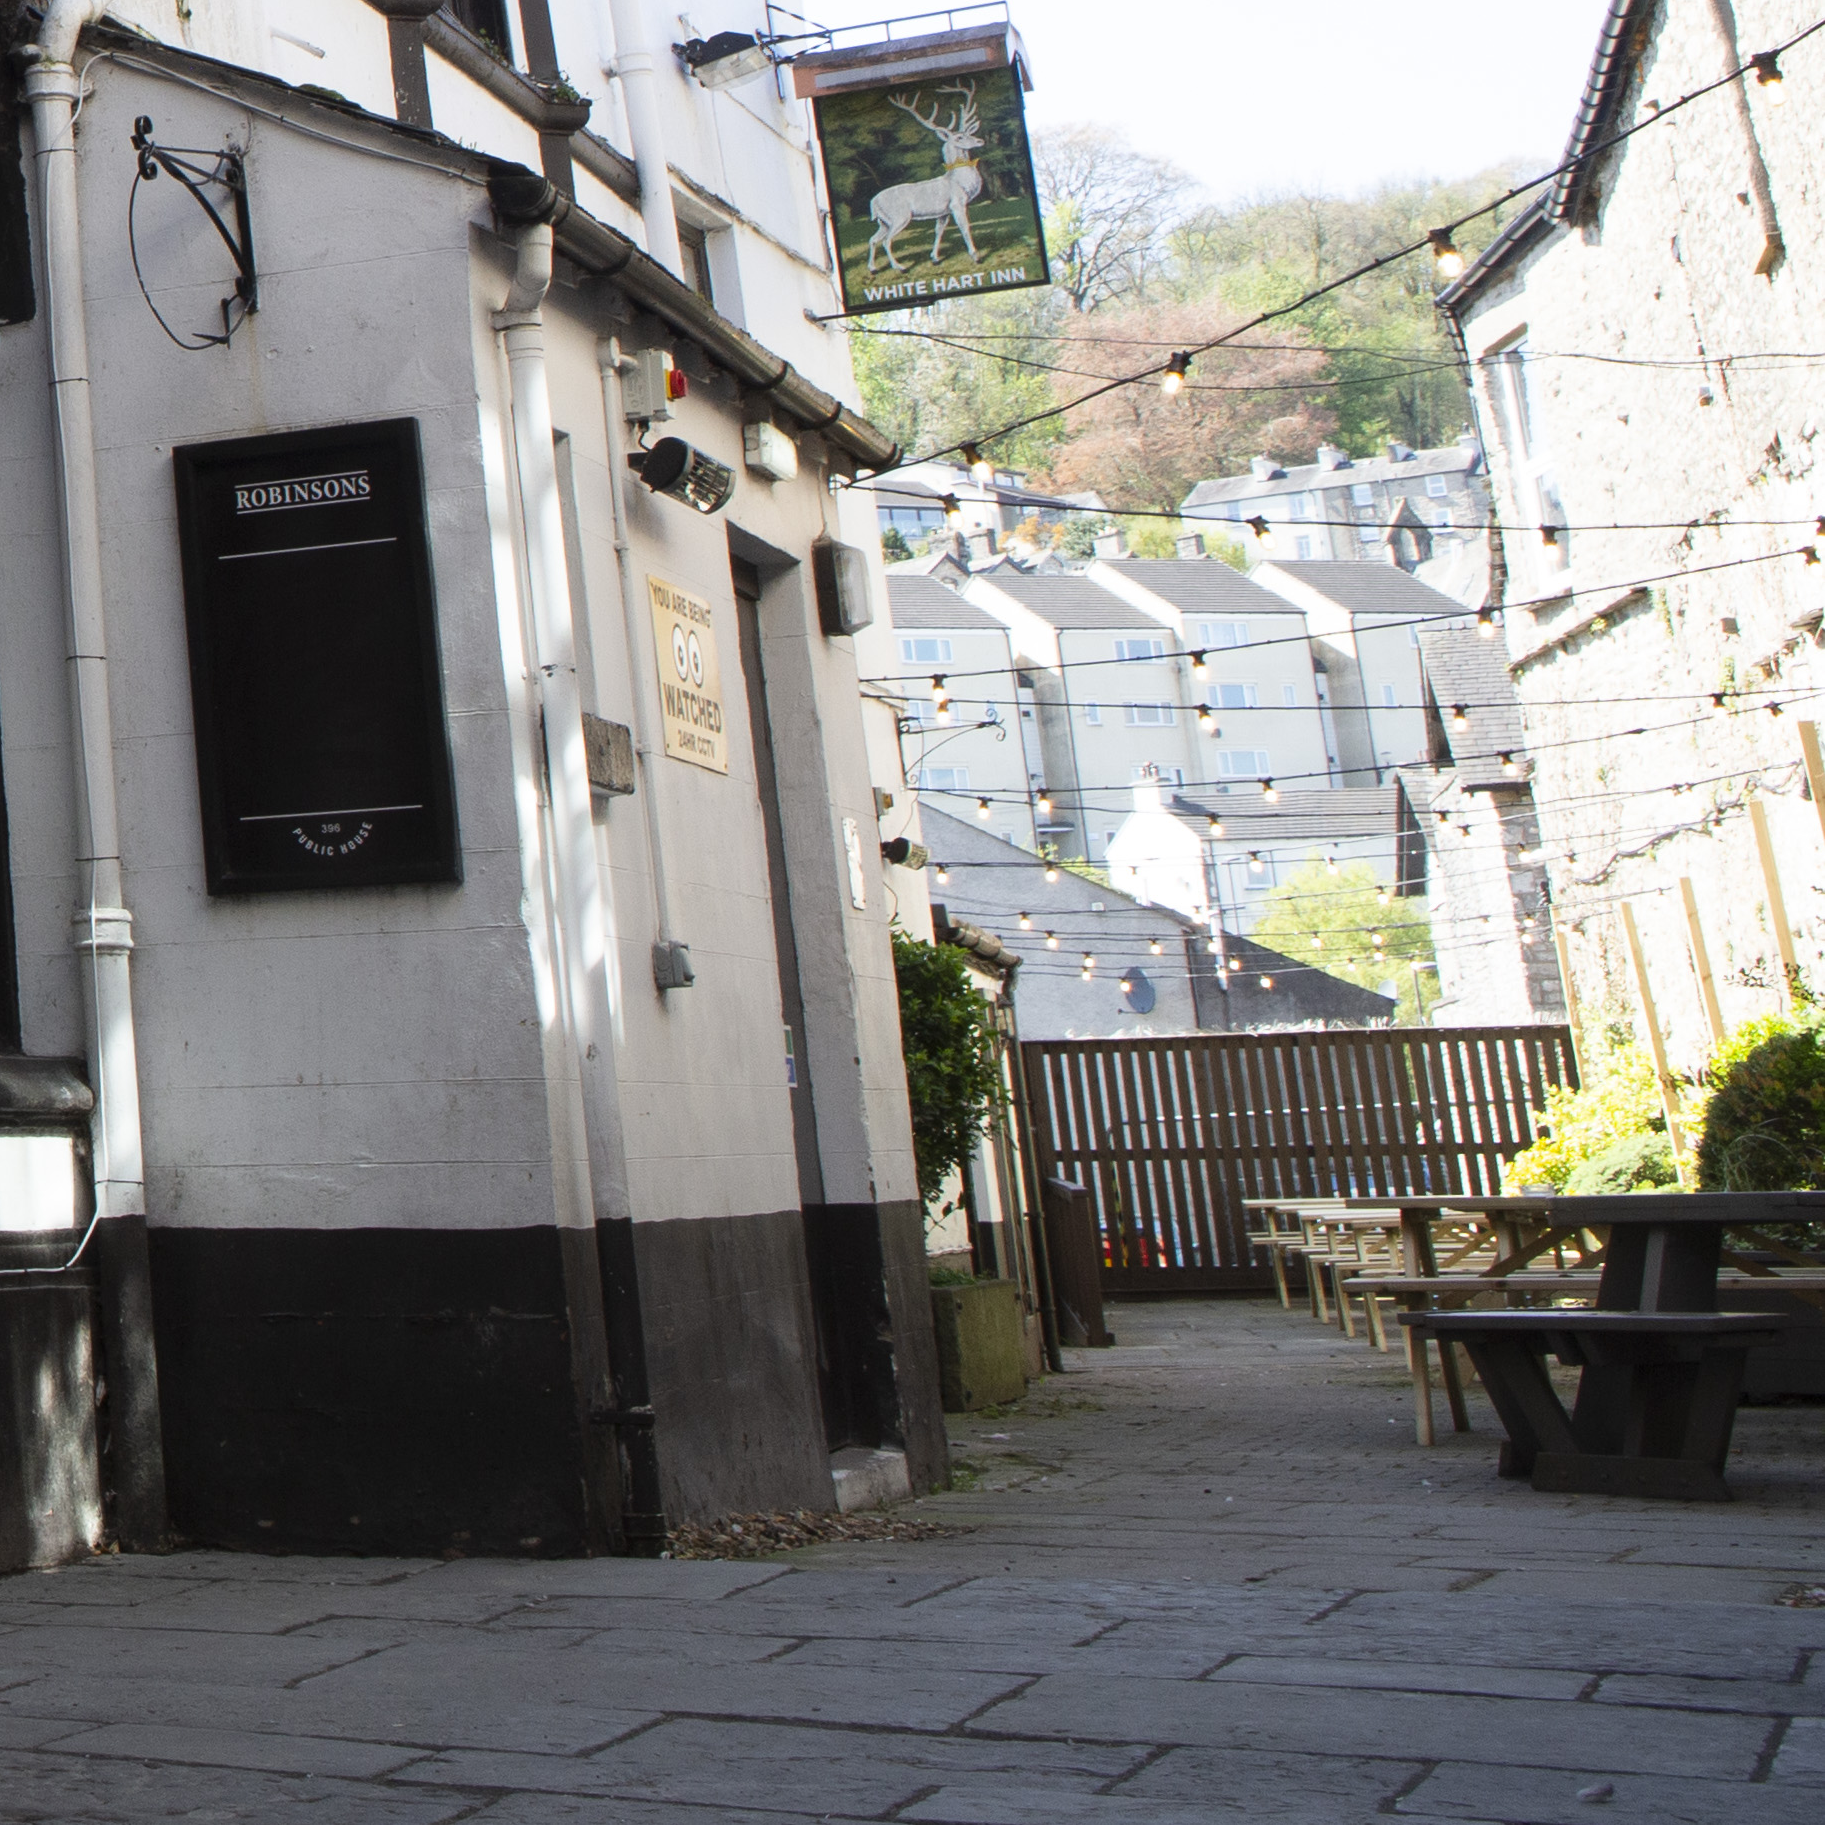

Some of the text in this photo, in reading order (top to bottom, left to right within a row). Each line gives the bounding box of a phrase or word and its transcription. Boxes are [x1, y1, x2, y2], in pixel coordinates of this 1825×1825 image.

[863, 266, 1026, 302] WHITE HART INN
[236, 475, 371, 509] ROBINSONS
[650, 582, 711, 629] YOU ARE BEING
[663, 682, 722, 735] WATCHED
[678, 729, 715, 759] 24HR CCTV
[292, 821, 373, 856] PUBLIC HOUSE
[321, 823, 341, 834] 396
